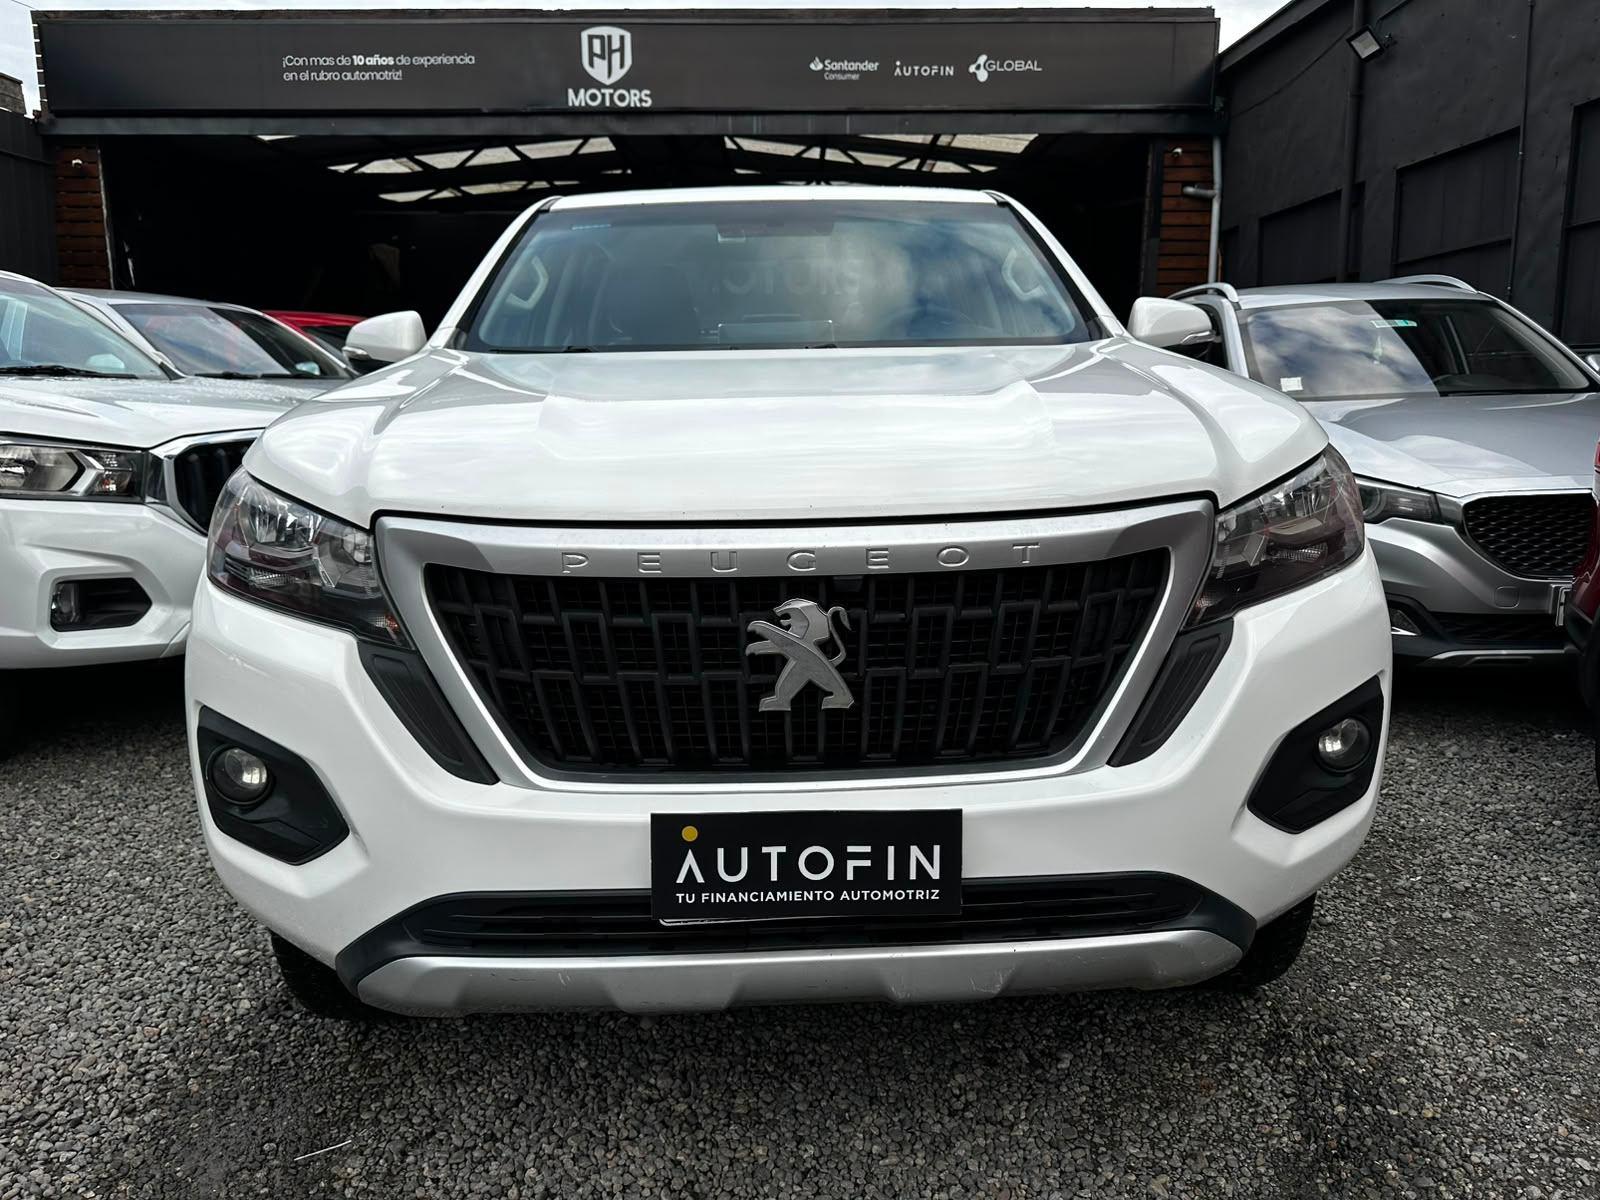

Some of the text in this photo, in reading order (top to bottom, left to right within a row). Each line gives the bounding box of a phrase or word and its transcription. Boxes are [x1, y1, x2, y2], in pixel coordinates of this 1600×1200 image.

[310, 56, 335, 66] mas
[336, 54, 351, 66] de
[352, 54, 364, 66] 10
[365, 54, 394, 66] años
[396, 54, 411, 66] de
[412, 52, 475, 68] experiencia
[824, 59, 880, 72] Santander
[985, 60, 1042, 72] GLOBAL
[283, 69, 402, 81] en el rubro automotriz!
[894, 61, 954, 76] AUTOFIN
[824, 72, 860, 81] Consumer
[568, 88, 652, 107] MOTORS
[561, 544, 1040, 574] PEUGEOT
[676, 843, 941, 883] AUTOFIN
[676, 889, 940, 904] TU FINANCIAMIENTO AUTOMOTRIZ
